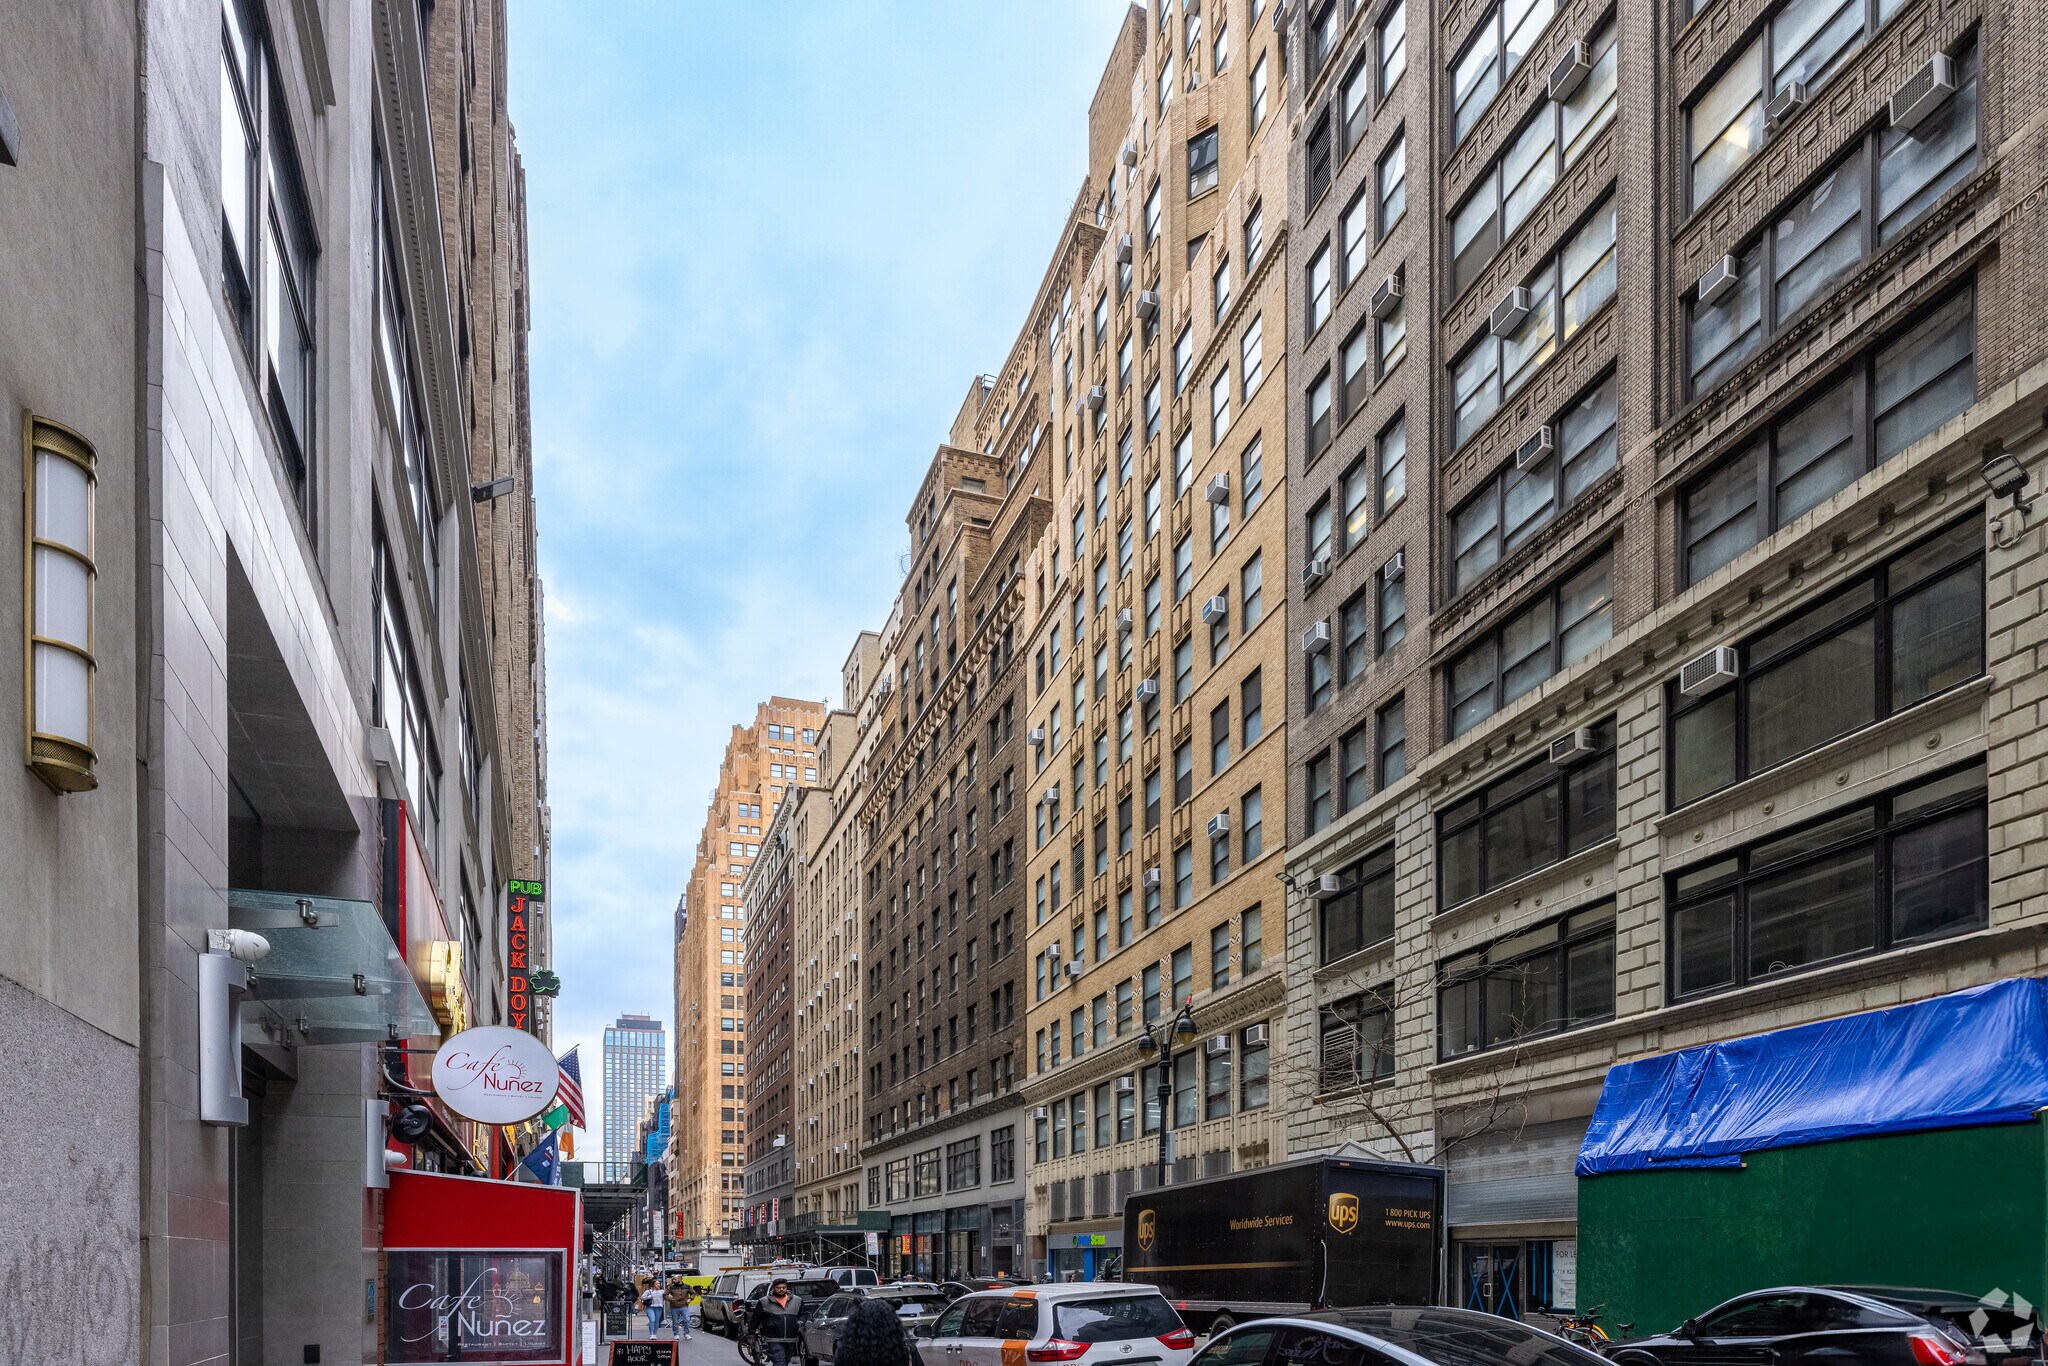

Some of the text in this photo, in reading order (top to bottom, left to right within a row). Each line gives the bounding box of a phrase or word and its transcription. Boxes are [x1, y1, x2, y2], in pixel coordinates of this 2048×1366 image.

[510, 880, 542, 895] PUB
[510, 897, 527, 1029] JACK DOY
[446, 1044, 512, 1091] Café
[483, 1072, 543, 1093] Nuñez
[1230, 1213, 1293, 1230] Worldwide Services
[1330, 1205, 1357, 1228] ups
[1390, 1208, 1402, 1217] 800
[1403, 1209, 1418, 1218] PICK
[1419, 1210, 1431, 1219] UPS
[1385, 1219, 1431, 1230] www.ups.com
[1139, 1221, 1154, 1246] ups
[1555, 1250, 1569, 1259] FOR
[457, 1310, 547, 1337] Nuñez
[626, 1344, 652, 1355] HAPPY
[627, 1355, 648, 1363] HOUR
